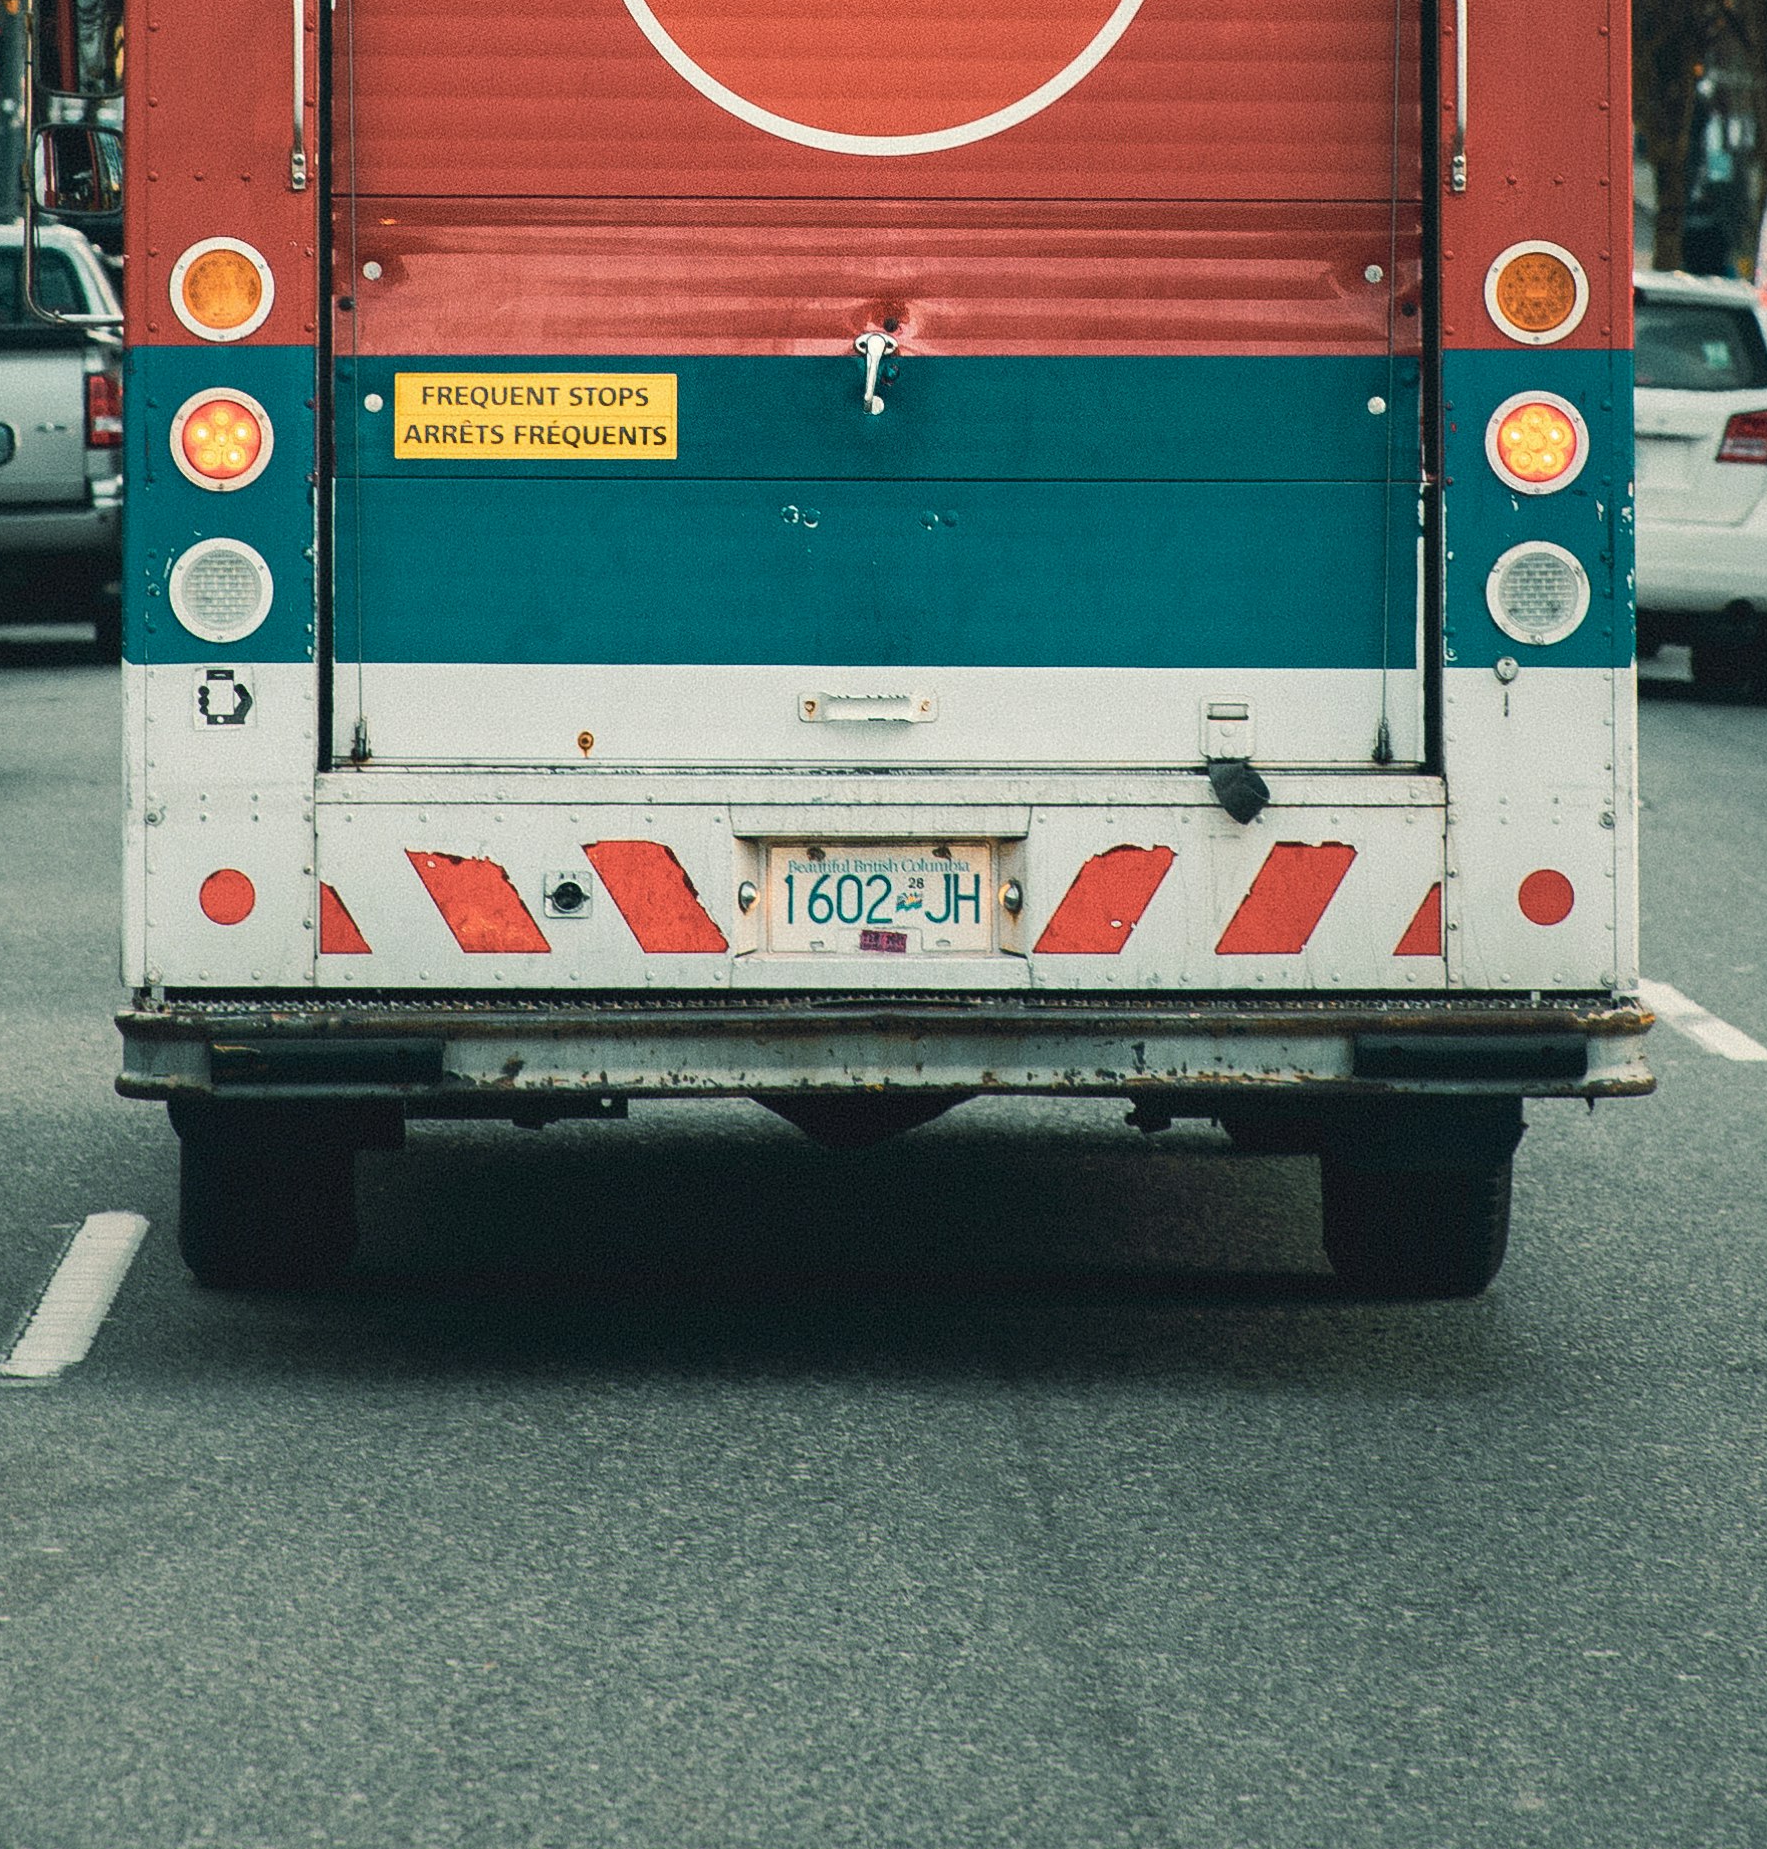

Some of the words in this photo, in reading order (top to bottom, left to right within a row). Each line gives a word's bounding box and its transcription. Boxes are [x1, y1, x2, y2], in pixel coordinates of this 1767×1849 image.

[422, 385, 560, 408] FREQUENT
[569, 387, 649, 407] STOPS
[404, 420, 505, 445] ARRÊTS
[514, 420, 668, 449] FRÉQUENTS
[788, 860, 850, 874] Beautiful
[854, 858, 898, 873] British
[901, 859, 970, 873] Columbia
[908, 877, 925, 889] 28
[784, 873, 893, 925] 1602
[924, 873, 981, 925] JH
